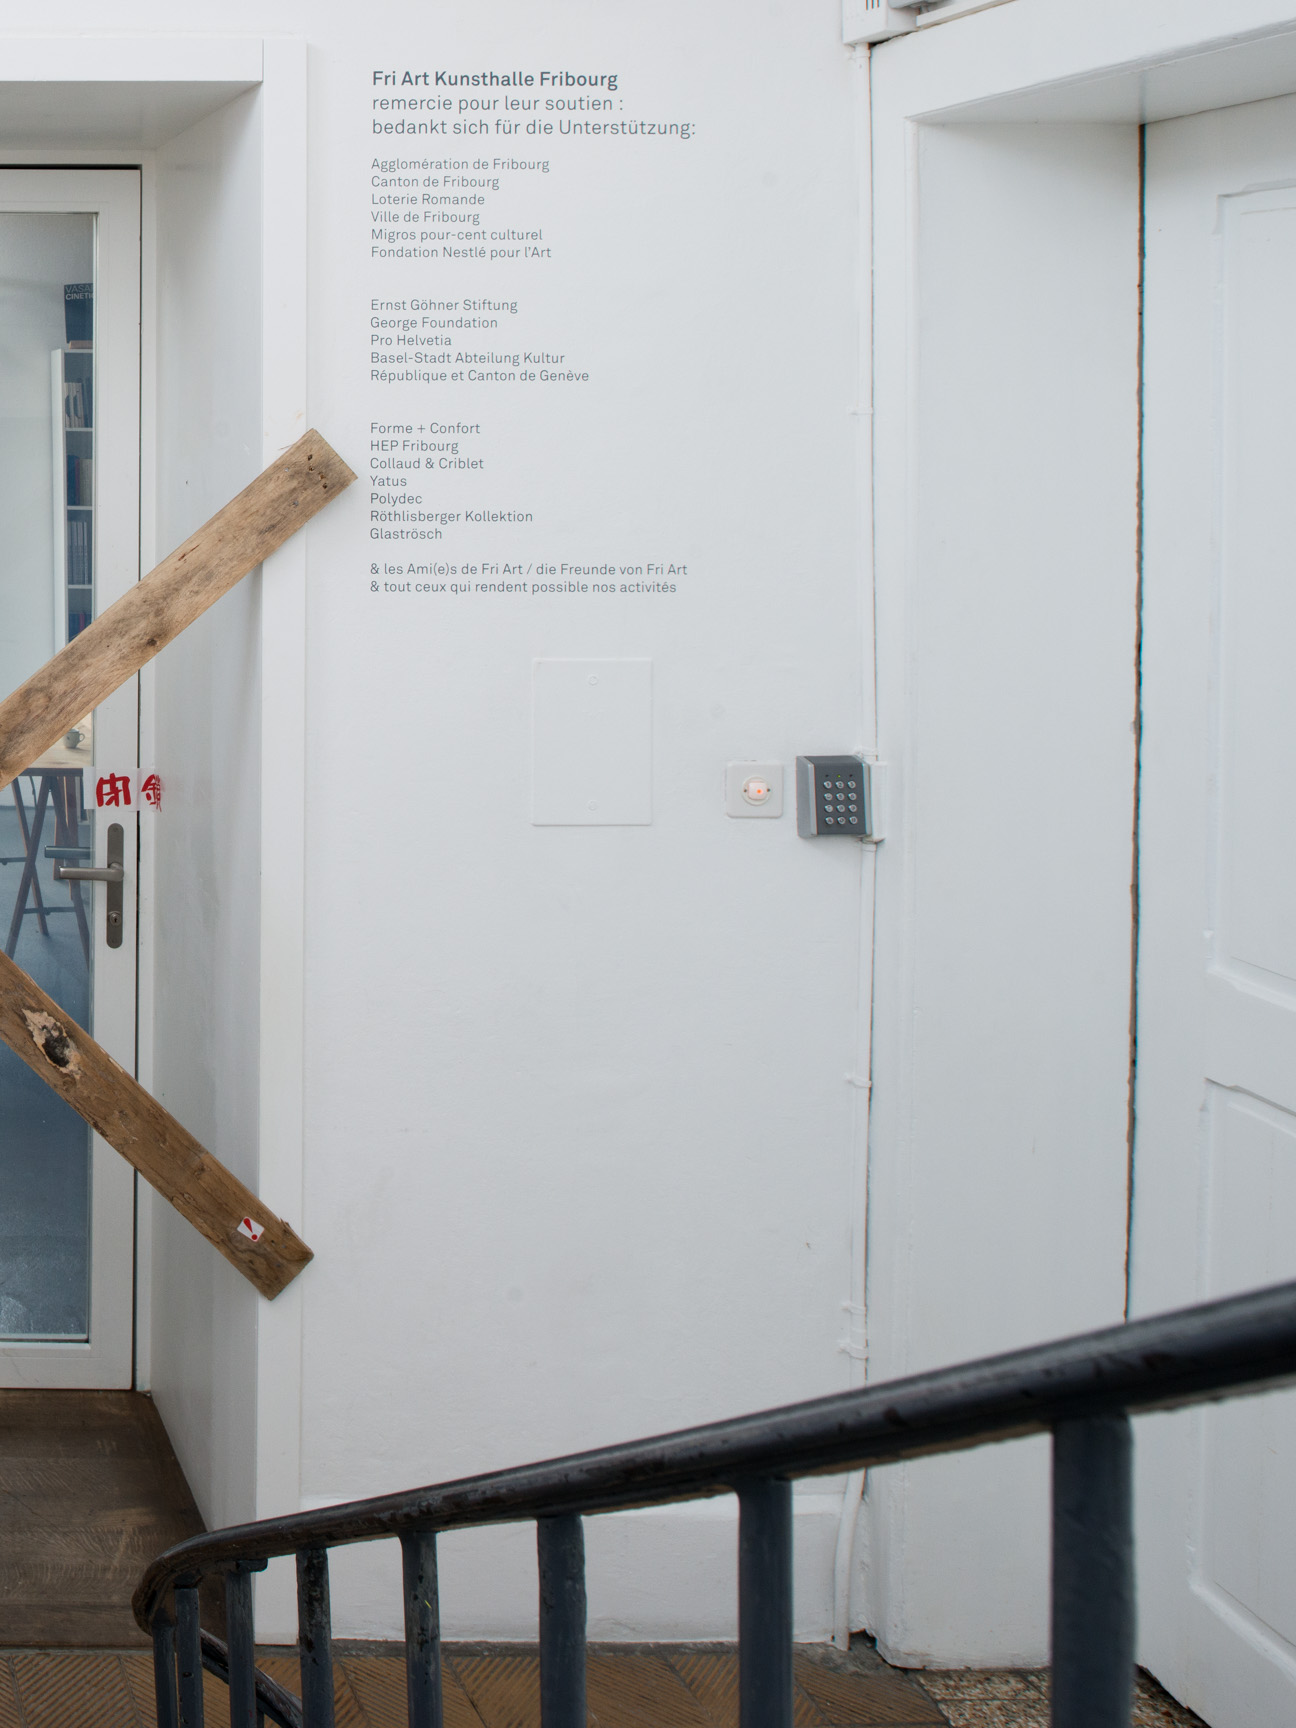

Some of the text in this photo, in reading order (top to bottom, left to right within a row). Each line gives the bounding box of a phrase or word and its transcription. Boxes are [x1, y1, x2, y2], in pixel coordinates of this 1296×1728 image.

[372, 70, 619, 92] Fri Art Kunsthalle Fribourg
[372, 94, 624, 115] remercie pour leur soutien :
[372, 118, 696, 140] bedankt sich für die Unterstützung:
[370, 157, 550, 174] Agglomération de Fribourg
[371, 175, 500, 191] Canton de Fribourg
[371, 192, 486, 206] Loterie Romande
[370, 210, 481, 227] Ville de Fribourg
[371, 228, 543, 244] Migros pour-cent culturel
[371, 245, 439, 258] Fondation
[442, 245, 487, 259] Nestlé
[490, 248, 521, 261] pour
[65, 284, 93, 293] VASA
[65, 292, 93, 301] CINETI
[370, 298, 519, 315] Ernst Göhner Stiftung
[370, 316, 498, 332] George Foundation
[370, 333, 453, 347] Pro Helvetia
[370, 351, 566, 368] Basel-Stadt Abteilung Kultur
[370, 369, 590, 385] République et Canton de Genève
[370, 421, 481, 435] Forme + Confort
[370, 439, 460, 456] HEP Fribourg
[369, 456, 485, 470] Collaud & Criblet
[369, 474, 408, 487] Yatus
[370, 492, 423, 508] Polydec
[370, 509, 533, 526] Röthlisberger Kollektion
[369, 527, 443, 540] Glaströsch
[369, 561, 688, 577] & les Ami(e)s de Fri Art / die Freunde von Fri Art
[369, 580, 677, 596] & tout ceux qui rendent possible nos activités
